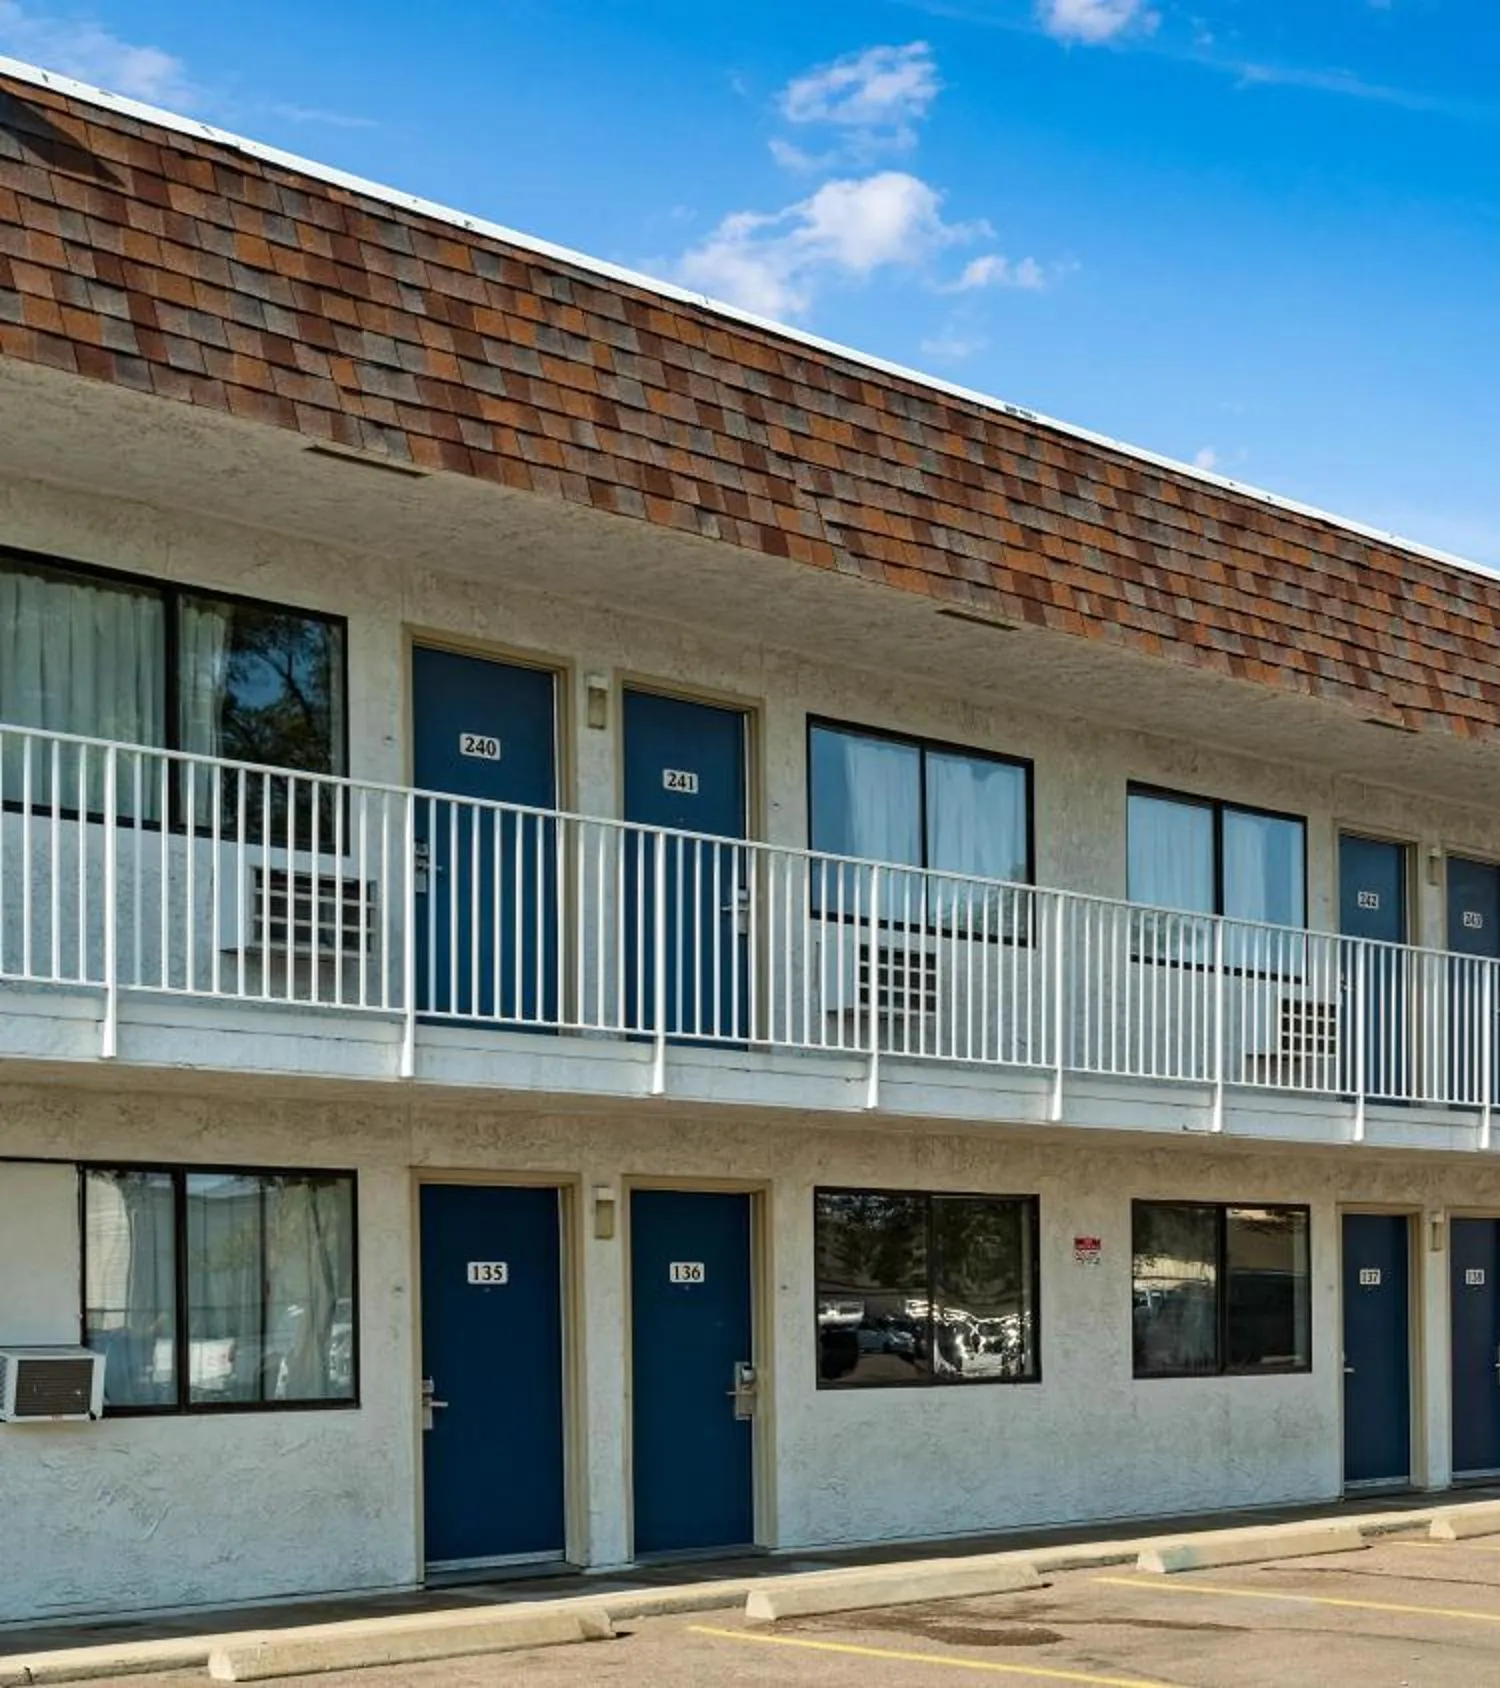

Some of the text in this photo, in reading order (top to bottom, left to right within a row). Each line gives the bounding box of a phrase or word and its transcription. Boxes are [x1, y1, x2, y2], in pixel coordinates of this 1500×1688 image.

[465, 736, 497, 757] 240
[667, 771, 694, 791] 241
[1360, 893, 1377, 907] 242
[473, 1264, 503, 1281] 135
[674, 1264, 701, 1281] 136
[1361, 1271, 1379, 1283] 137
